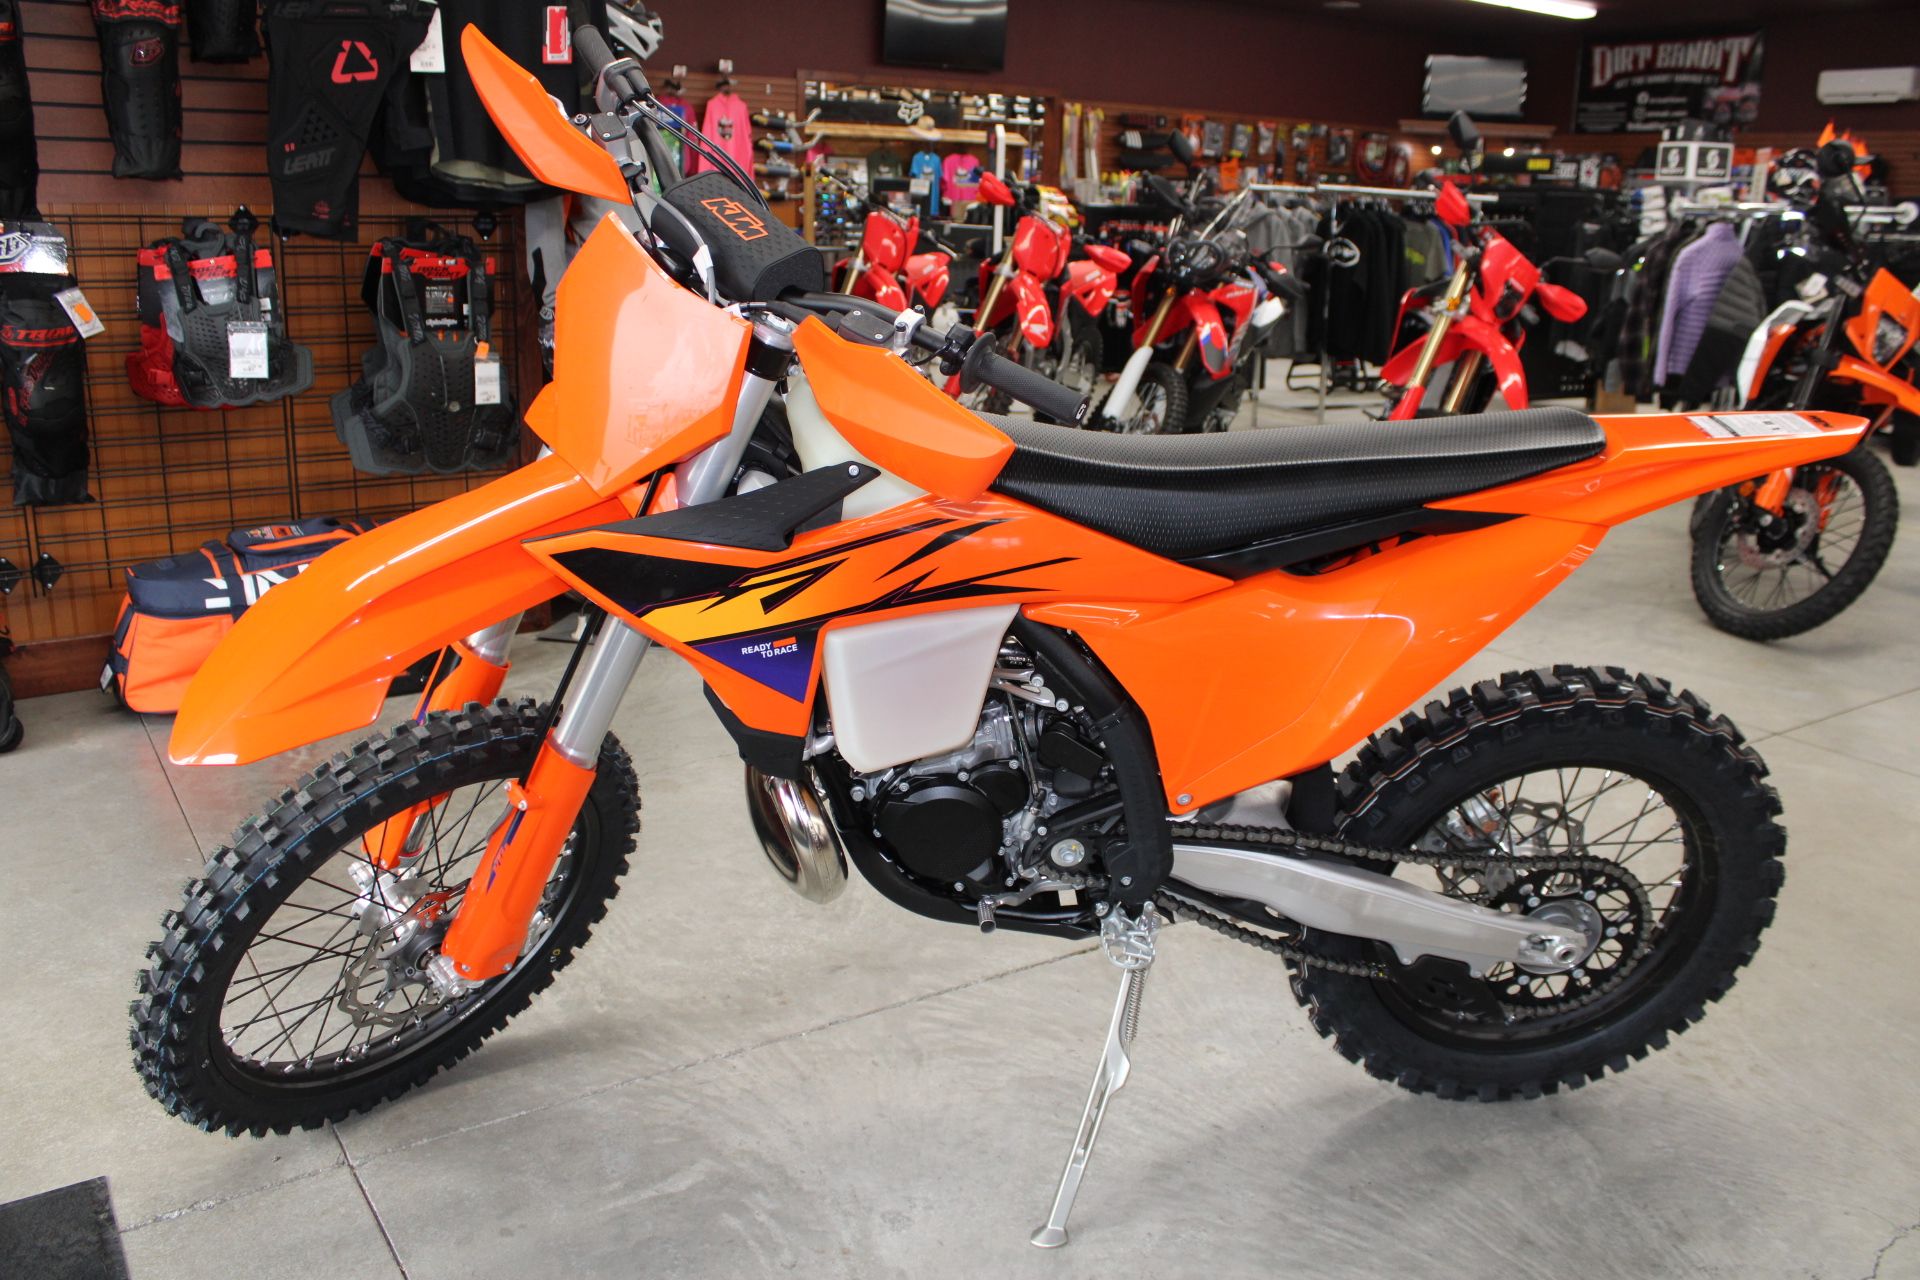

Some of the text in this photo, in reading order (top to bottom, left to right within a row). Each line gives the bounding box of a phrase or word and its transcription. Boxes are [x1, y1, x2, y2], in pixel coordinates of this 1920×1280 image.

[1592, 36, 1753, 88] DIRT BANDIT
[700, 197, 769, 241] KTM
[741, 642, 772, 655] READY
[761, 643, 798, 659] TO RACE
